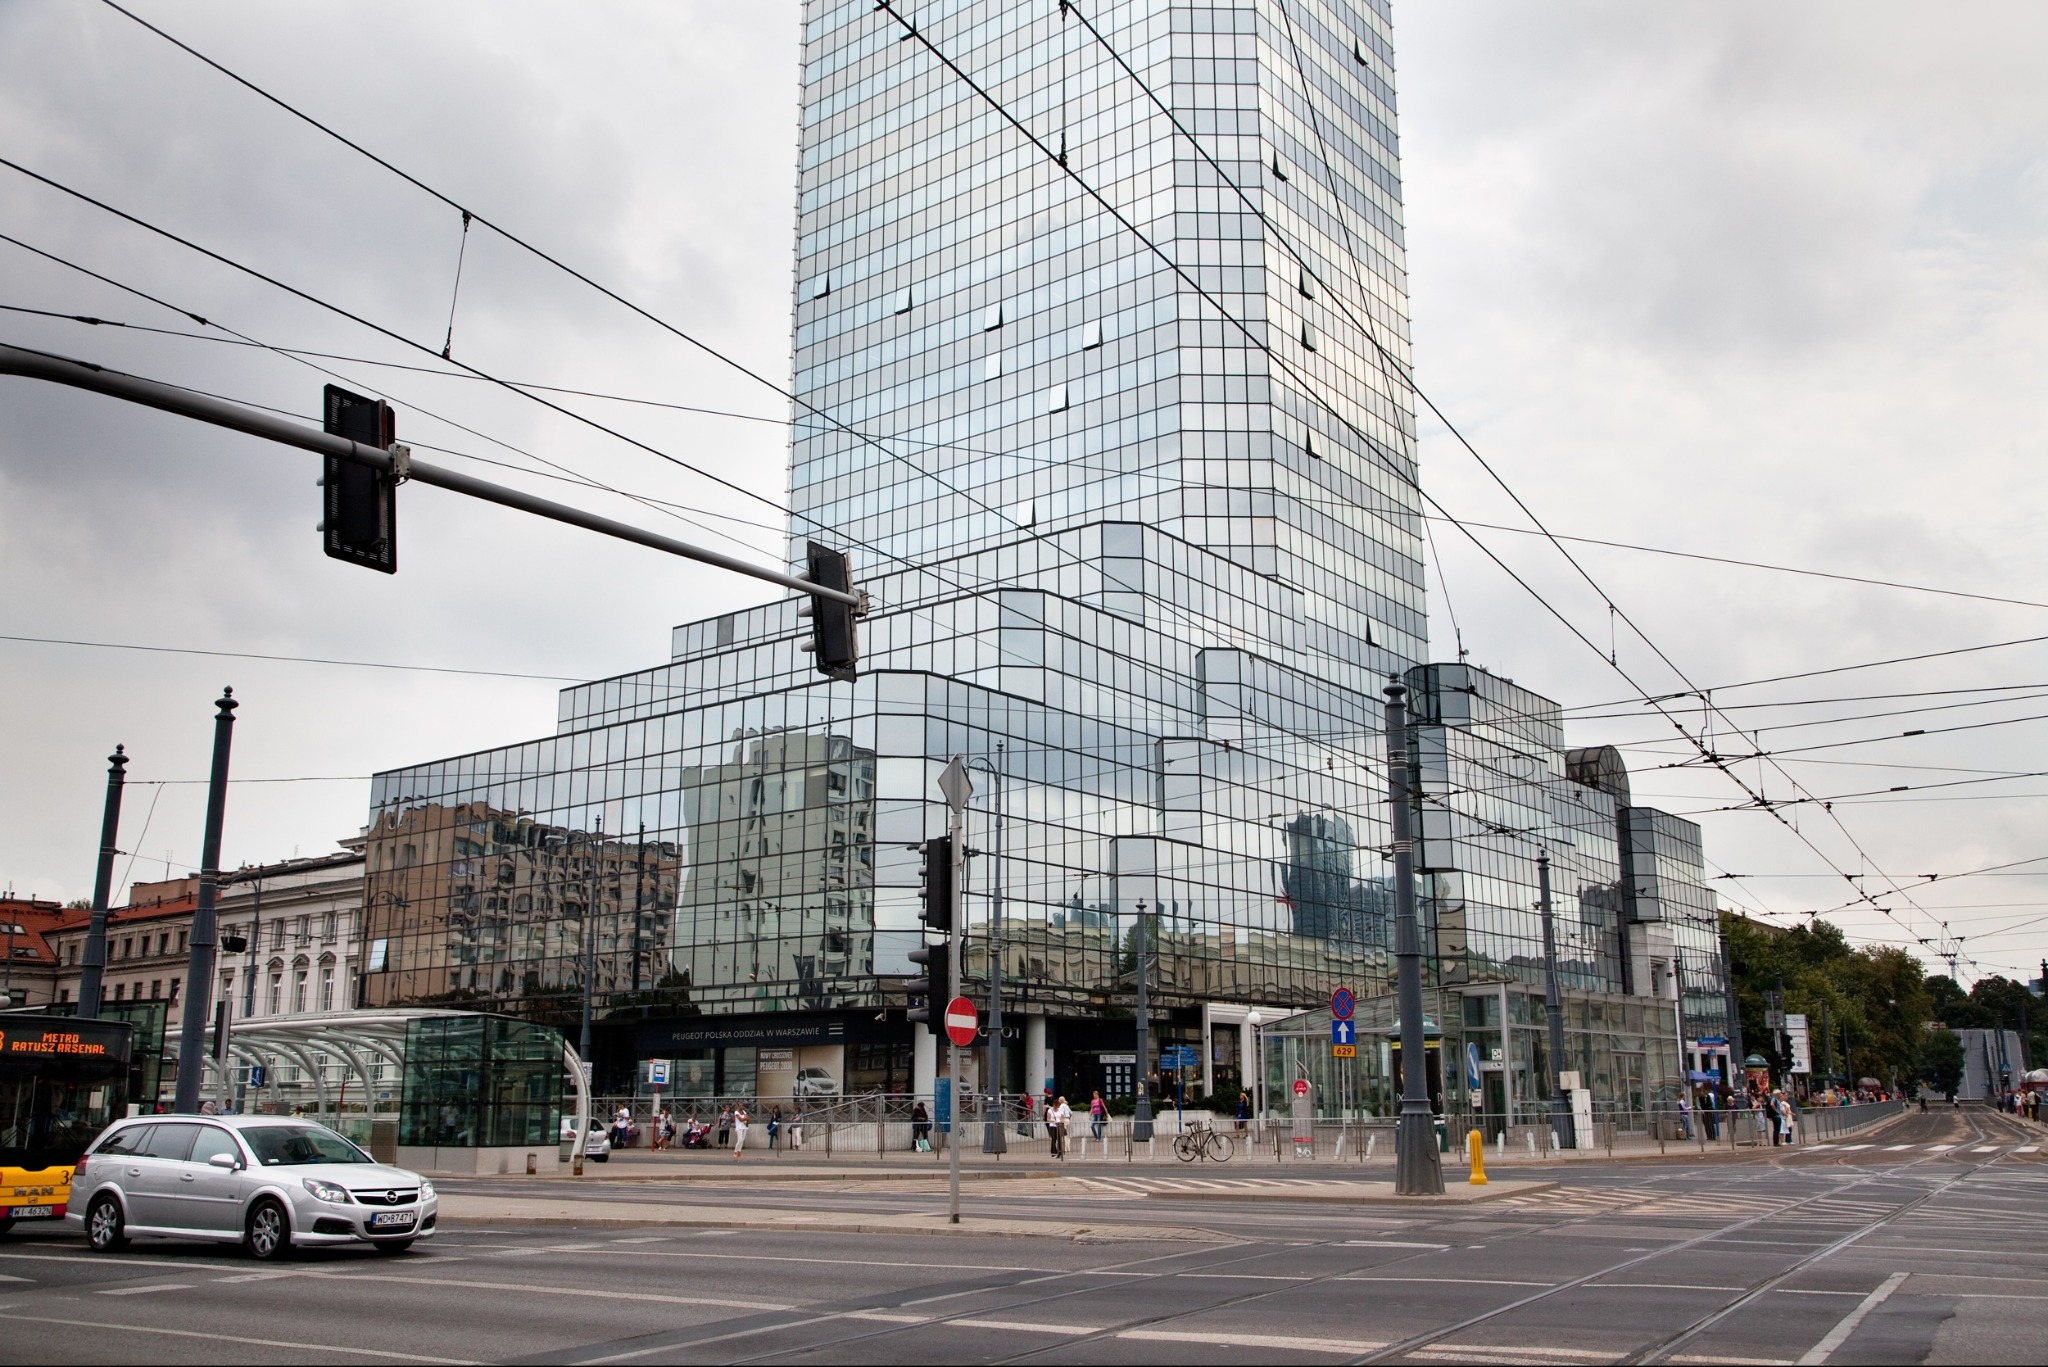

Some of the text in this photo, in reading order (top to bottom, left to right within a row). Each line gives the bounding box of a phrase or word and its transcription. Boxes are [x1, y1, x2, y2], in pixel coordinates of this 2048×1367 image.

[43, 1033, 79, 1043] METRO
[672, 1027, 820, 1040] PEUGEOT POLSKA ODDZIAŁ W WARSZAWIE
[12, 1041, 55, 1052] RATUSZ
[57, 1043, 105, 1054] ARSENAŁ
[1336, 1047, 1352, 1056] 629
[771, 1051, 793, 1059] CROSSOVER
[760, 1061, 780, 1070] PEUGEOT
[14, 1186, 54, 1197] MAN
[377, 1214, 388, 1224] WD
